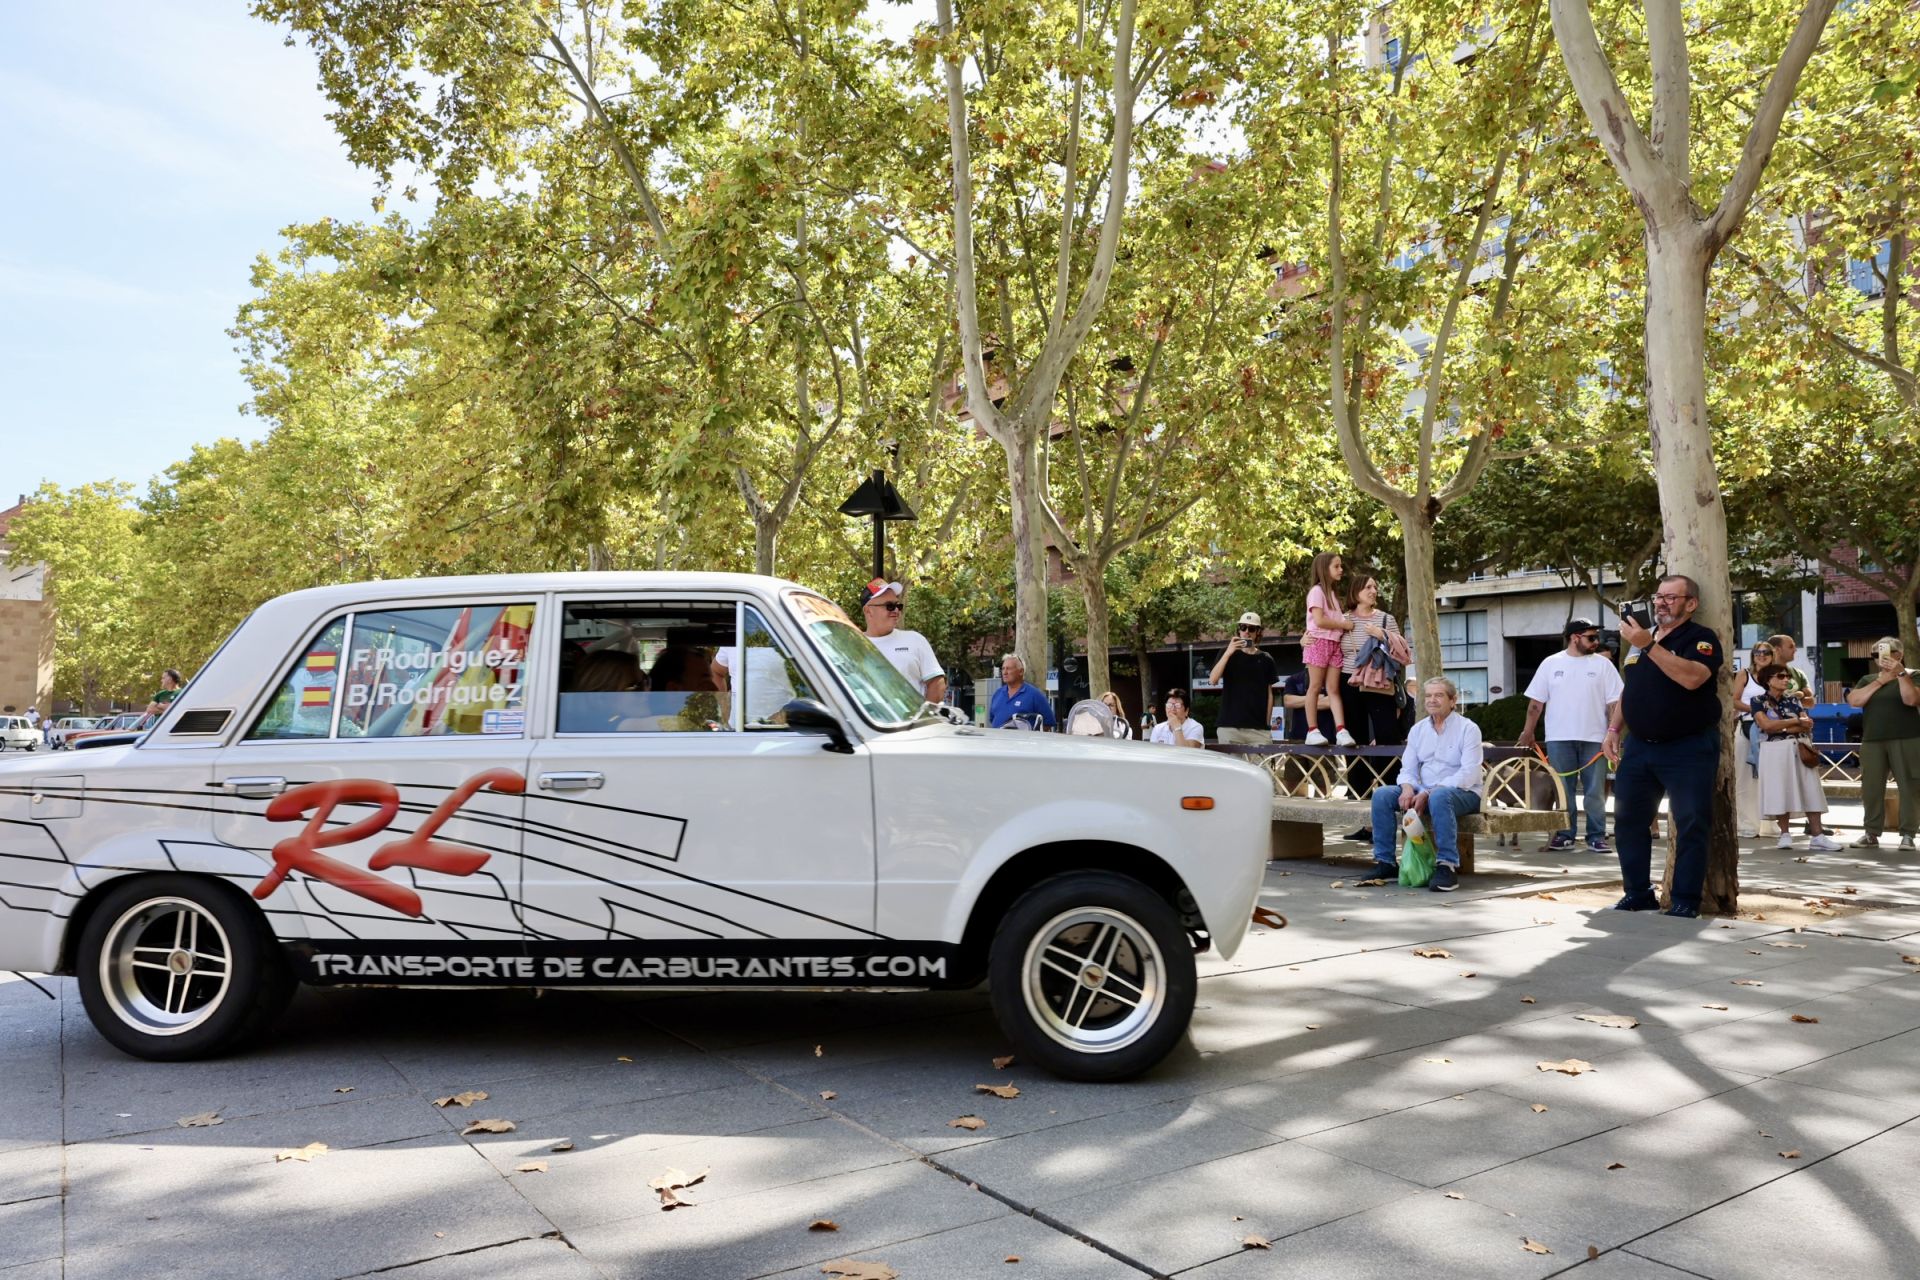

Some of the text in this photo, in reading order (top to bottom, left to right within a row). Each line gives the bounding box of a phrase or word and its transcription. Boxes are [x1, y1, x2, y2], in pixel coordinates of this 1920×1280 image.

[311, 954, 946, 979] TRANSPORTE DE CARBURANTES.COM
